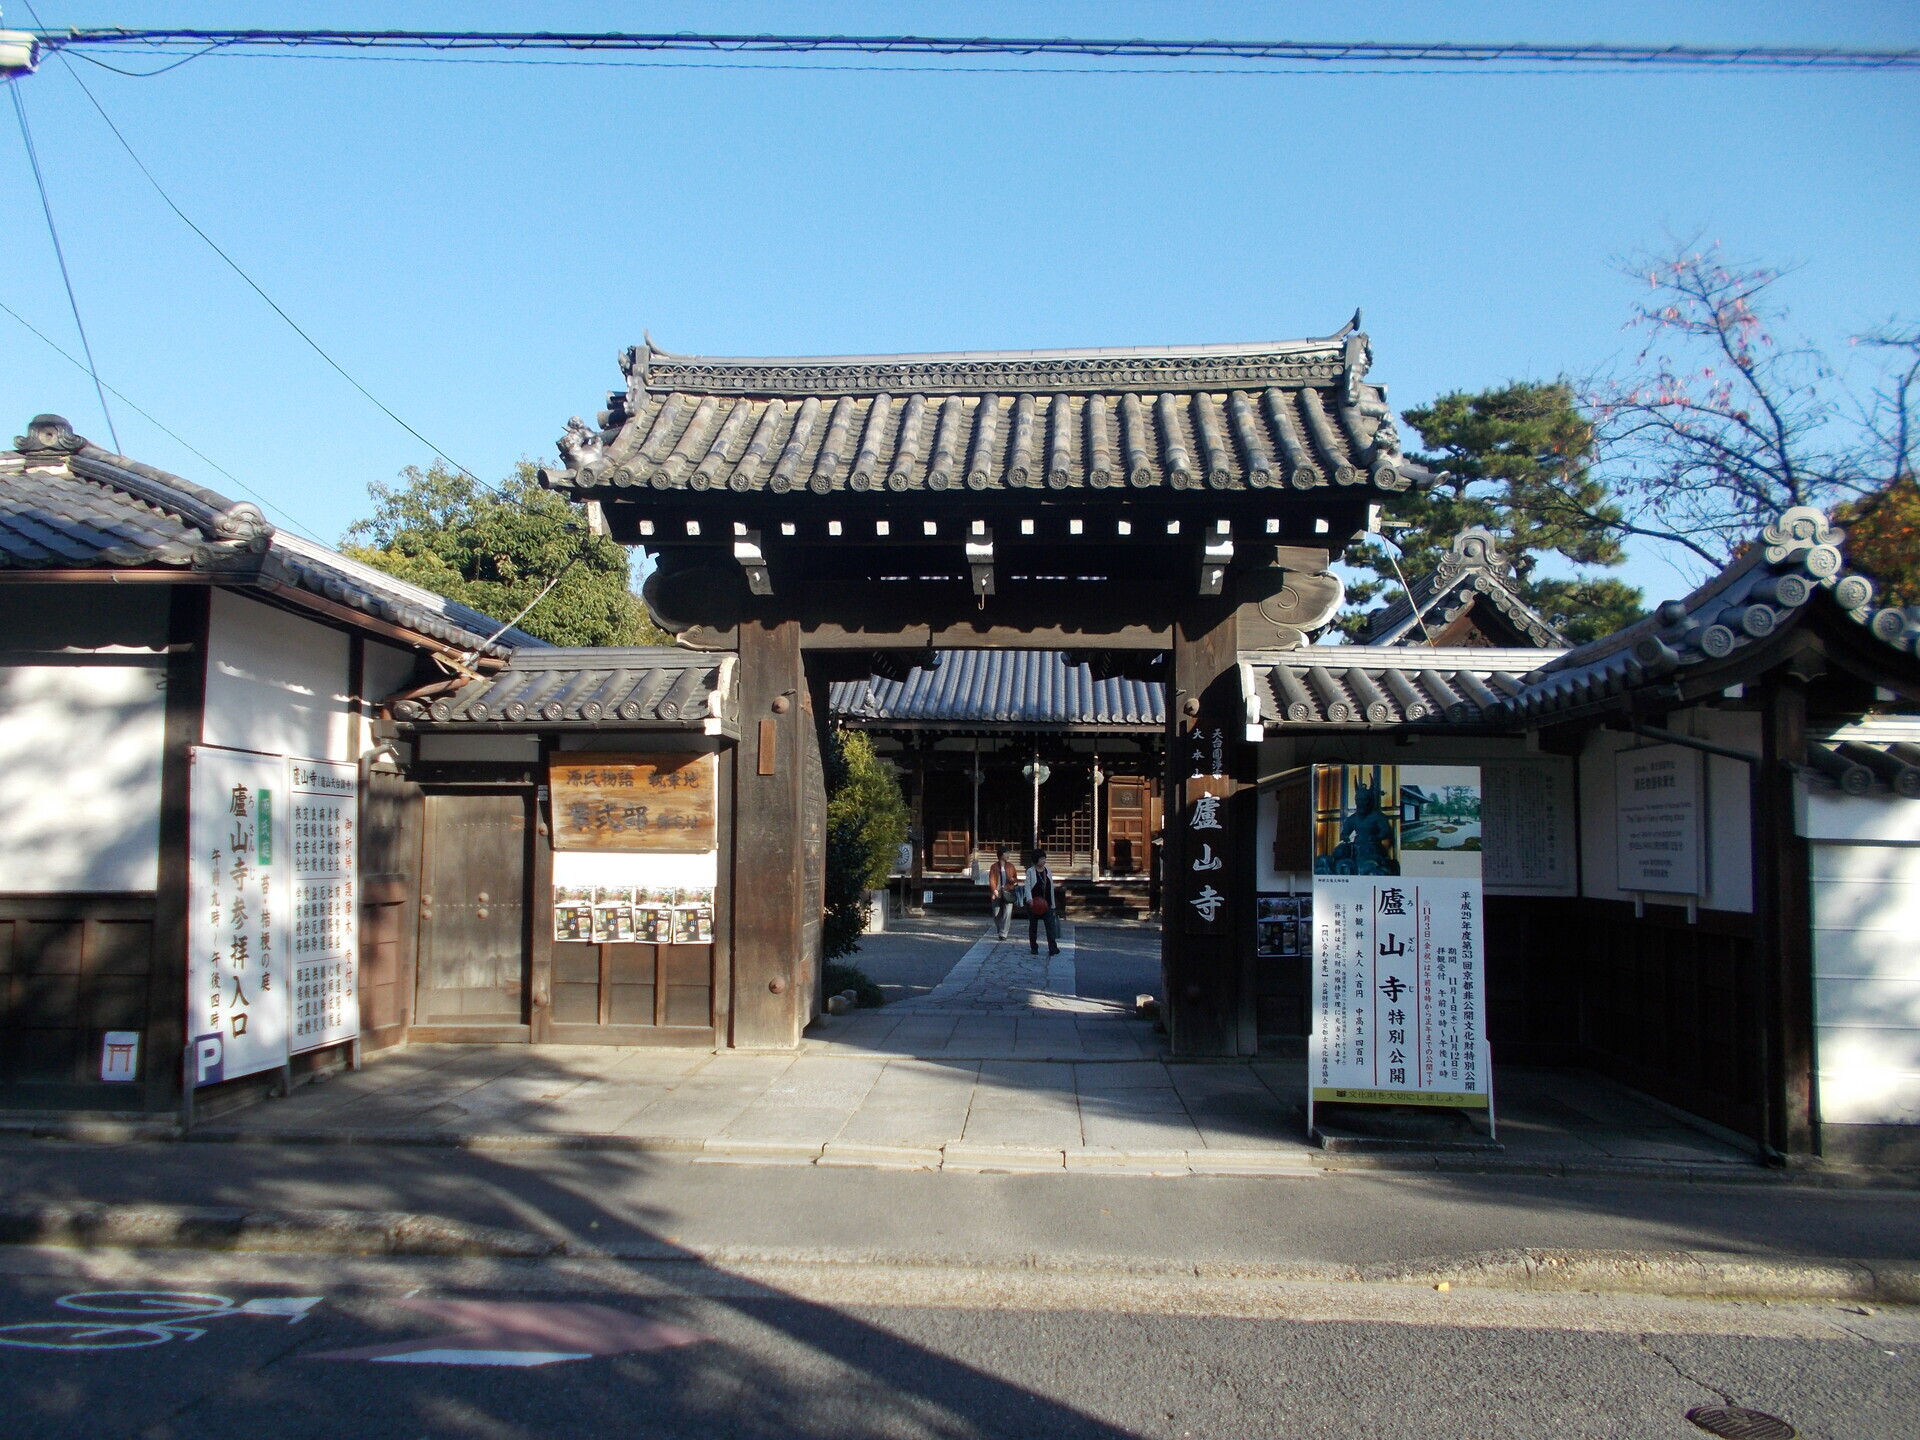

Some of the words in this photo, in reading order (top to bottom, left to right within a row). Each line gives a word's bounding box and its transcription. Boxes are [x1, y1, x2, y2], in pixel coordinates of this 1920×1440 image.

[1191, 728, 1205, 778] 大本山
[566, 769, 635, 787] 源氏物語
[568, 801, 649, 832] 紫式部
[1189, 791, 1225, 922] 廬山寺
[1407, 899, 1414, 907] ろ
[1354, 903, 1364, 940] 拝観料
[1354, 950, 1364, 967] 大人
[1407, 937, 1415, 953] ざん
[1448, 947, 1457, 964] 期間
[1437, 947, 1446, 980] 拝観受付
[1354, 971, 1364, 999] 八百円
[1408, 985, 1414, 993] じ
[1461, 891, 1476, 1091] 平成29年度第53回京都非公開文化財特別公開
[1355, 1007, 1364, 1035] 中高生
[197, 1038, 222, 1082] P
[1355, 1039, 1364, 1066] 四百円
[1349, 1090, 1464, 1102] 文化財を大切にしましょう
